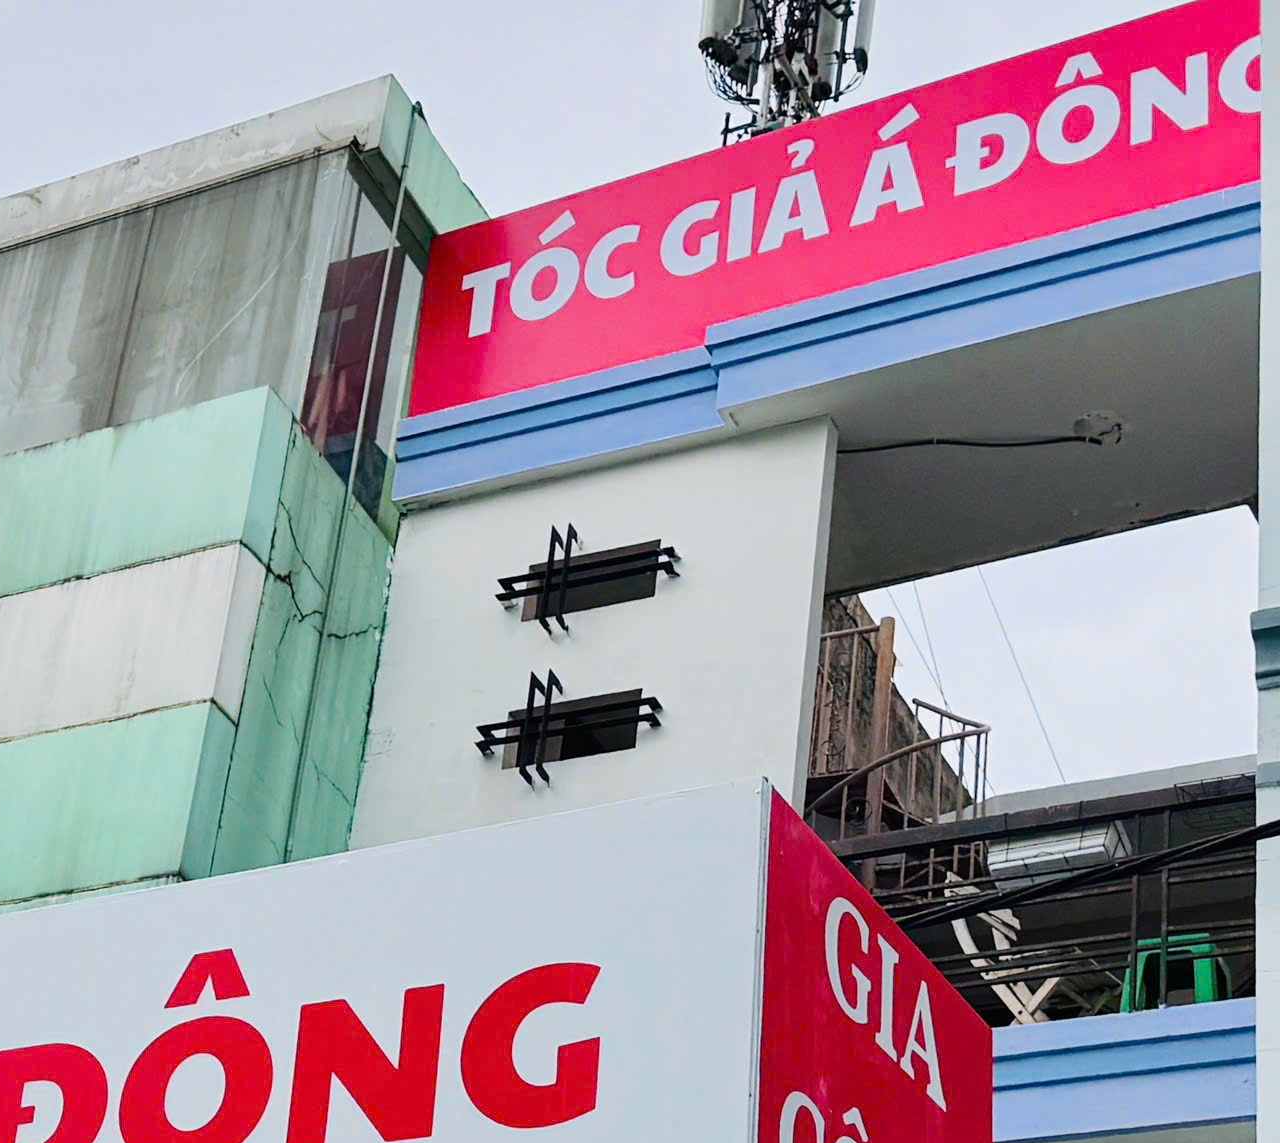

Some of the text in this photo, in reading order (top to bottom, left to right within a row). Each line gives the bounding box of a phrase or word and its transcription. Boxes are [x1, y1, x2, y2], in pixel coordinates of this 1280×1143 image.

[462, 209, 642, 338] TÓC
[660, 139, 830, 278] GIẢ
[850, 104, 924, 228] Á
[824, 897, 946, 1112] GIA
